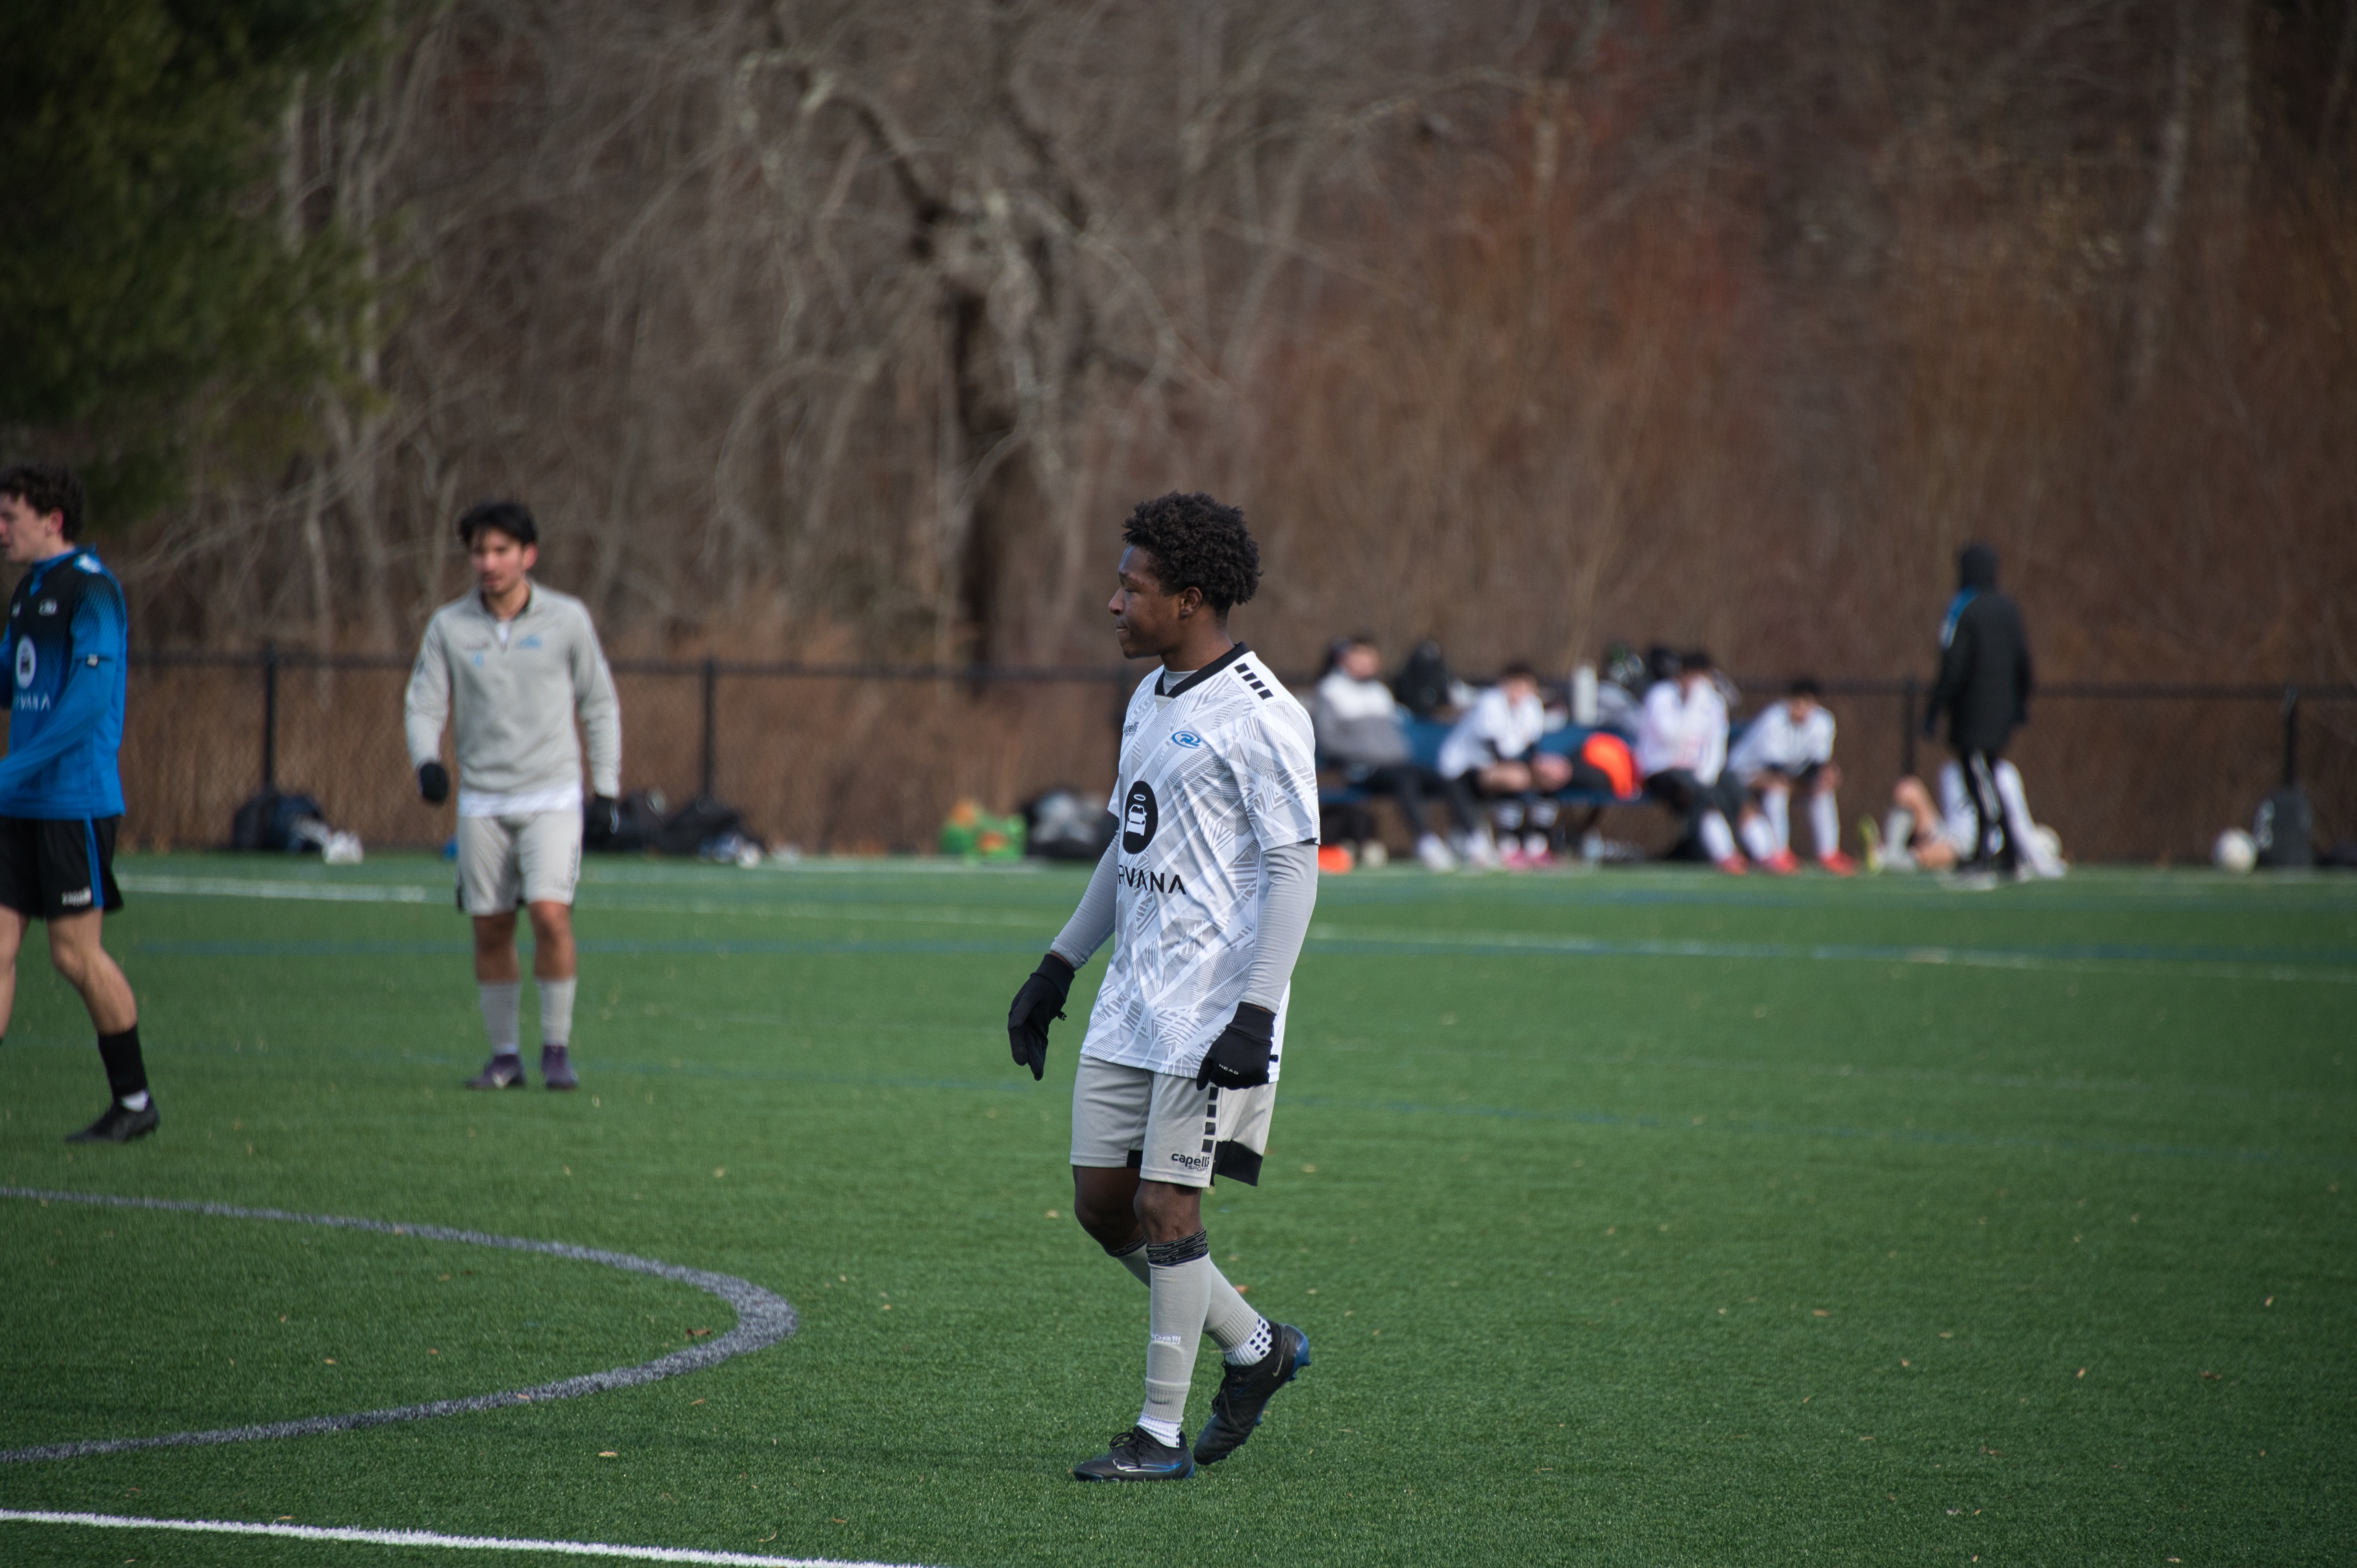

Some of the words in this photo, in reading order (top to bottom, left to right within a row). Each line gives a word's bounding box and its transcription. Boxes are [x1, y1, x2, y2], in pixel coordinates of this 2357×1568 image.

[1118, 864, 1186, 895] RVANA
[1219, 1064, 1239, 1075] HEAD
[1171, 1153, 1210, 1167] capelli
